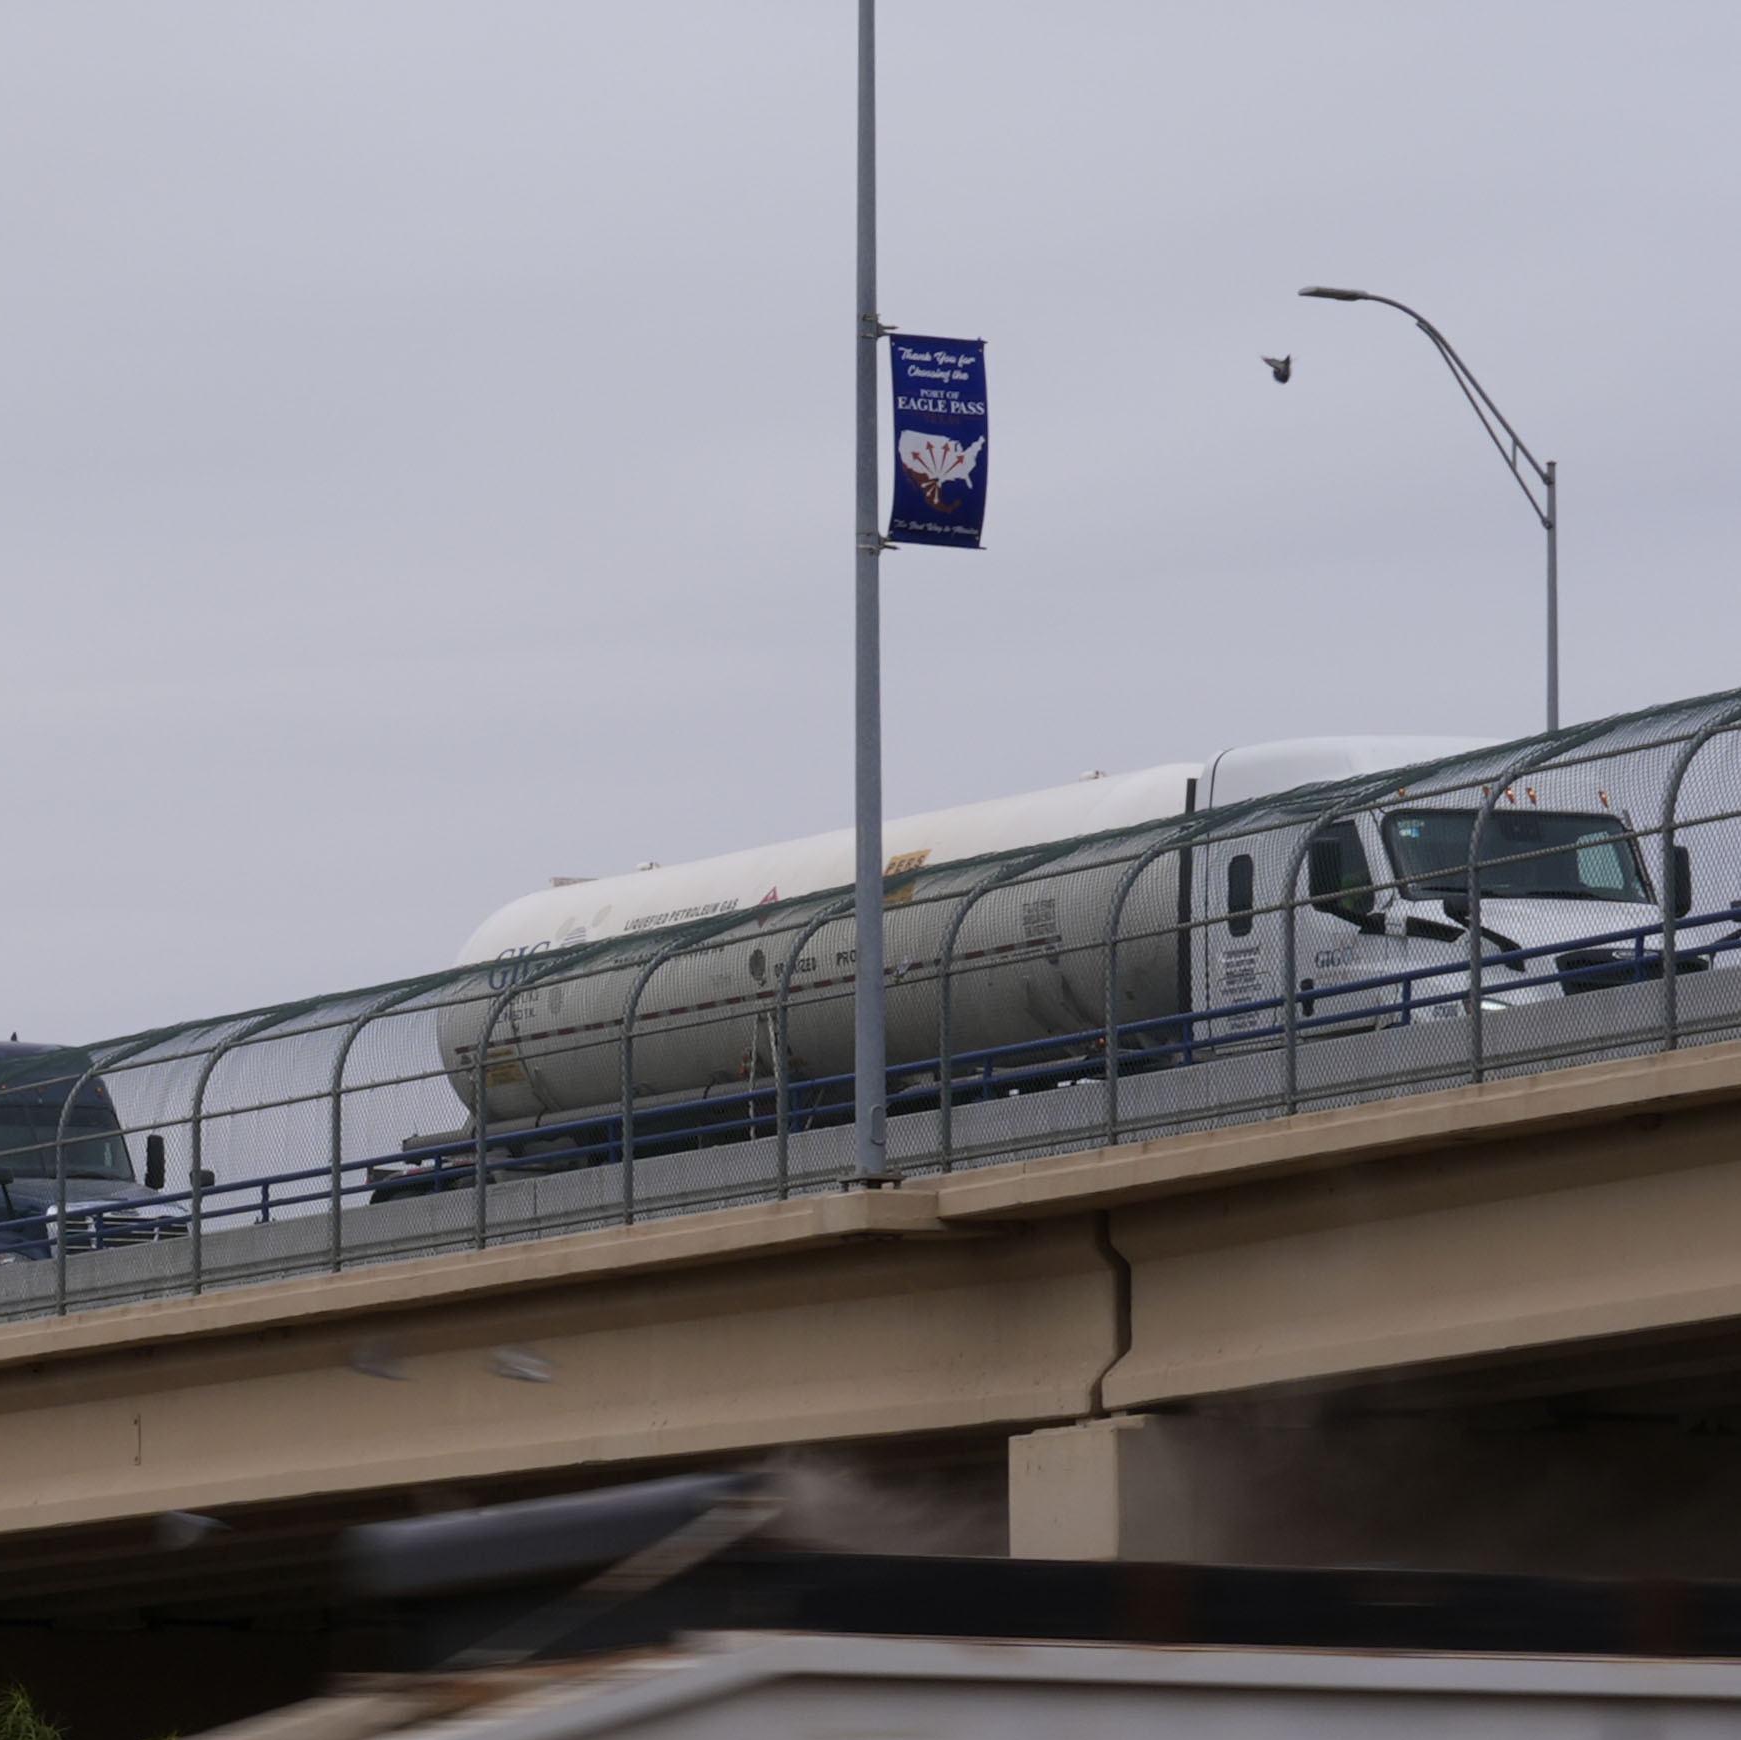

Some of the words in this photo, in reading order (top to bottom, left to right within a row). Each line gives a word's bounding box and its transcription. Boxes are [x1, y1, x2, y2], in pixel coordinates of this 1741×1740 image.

[898, 346, 932, 362] Thank
[933, 351, 956, 365] You
[957, 354, 976, 368] for
[951, 369, 969, 381] the
[920, 389, 945, 398] PORT
[946, 391, 960, 400] OF
[897, 395, 947, 413] EAGLE
[950, 400, 985, 415] PASS
[719, 898, 739, 912] GAS
